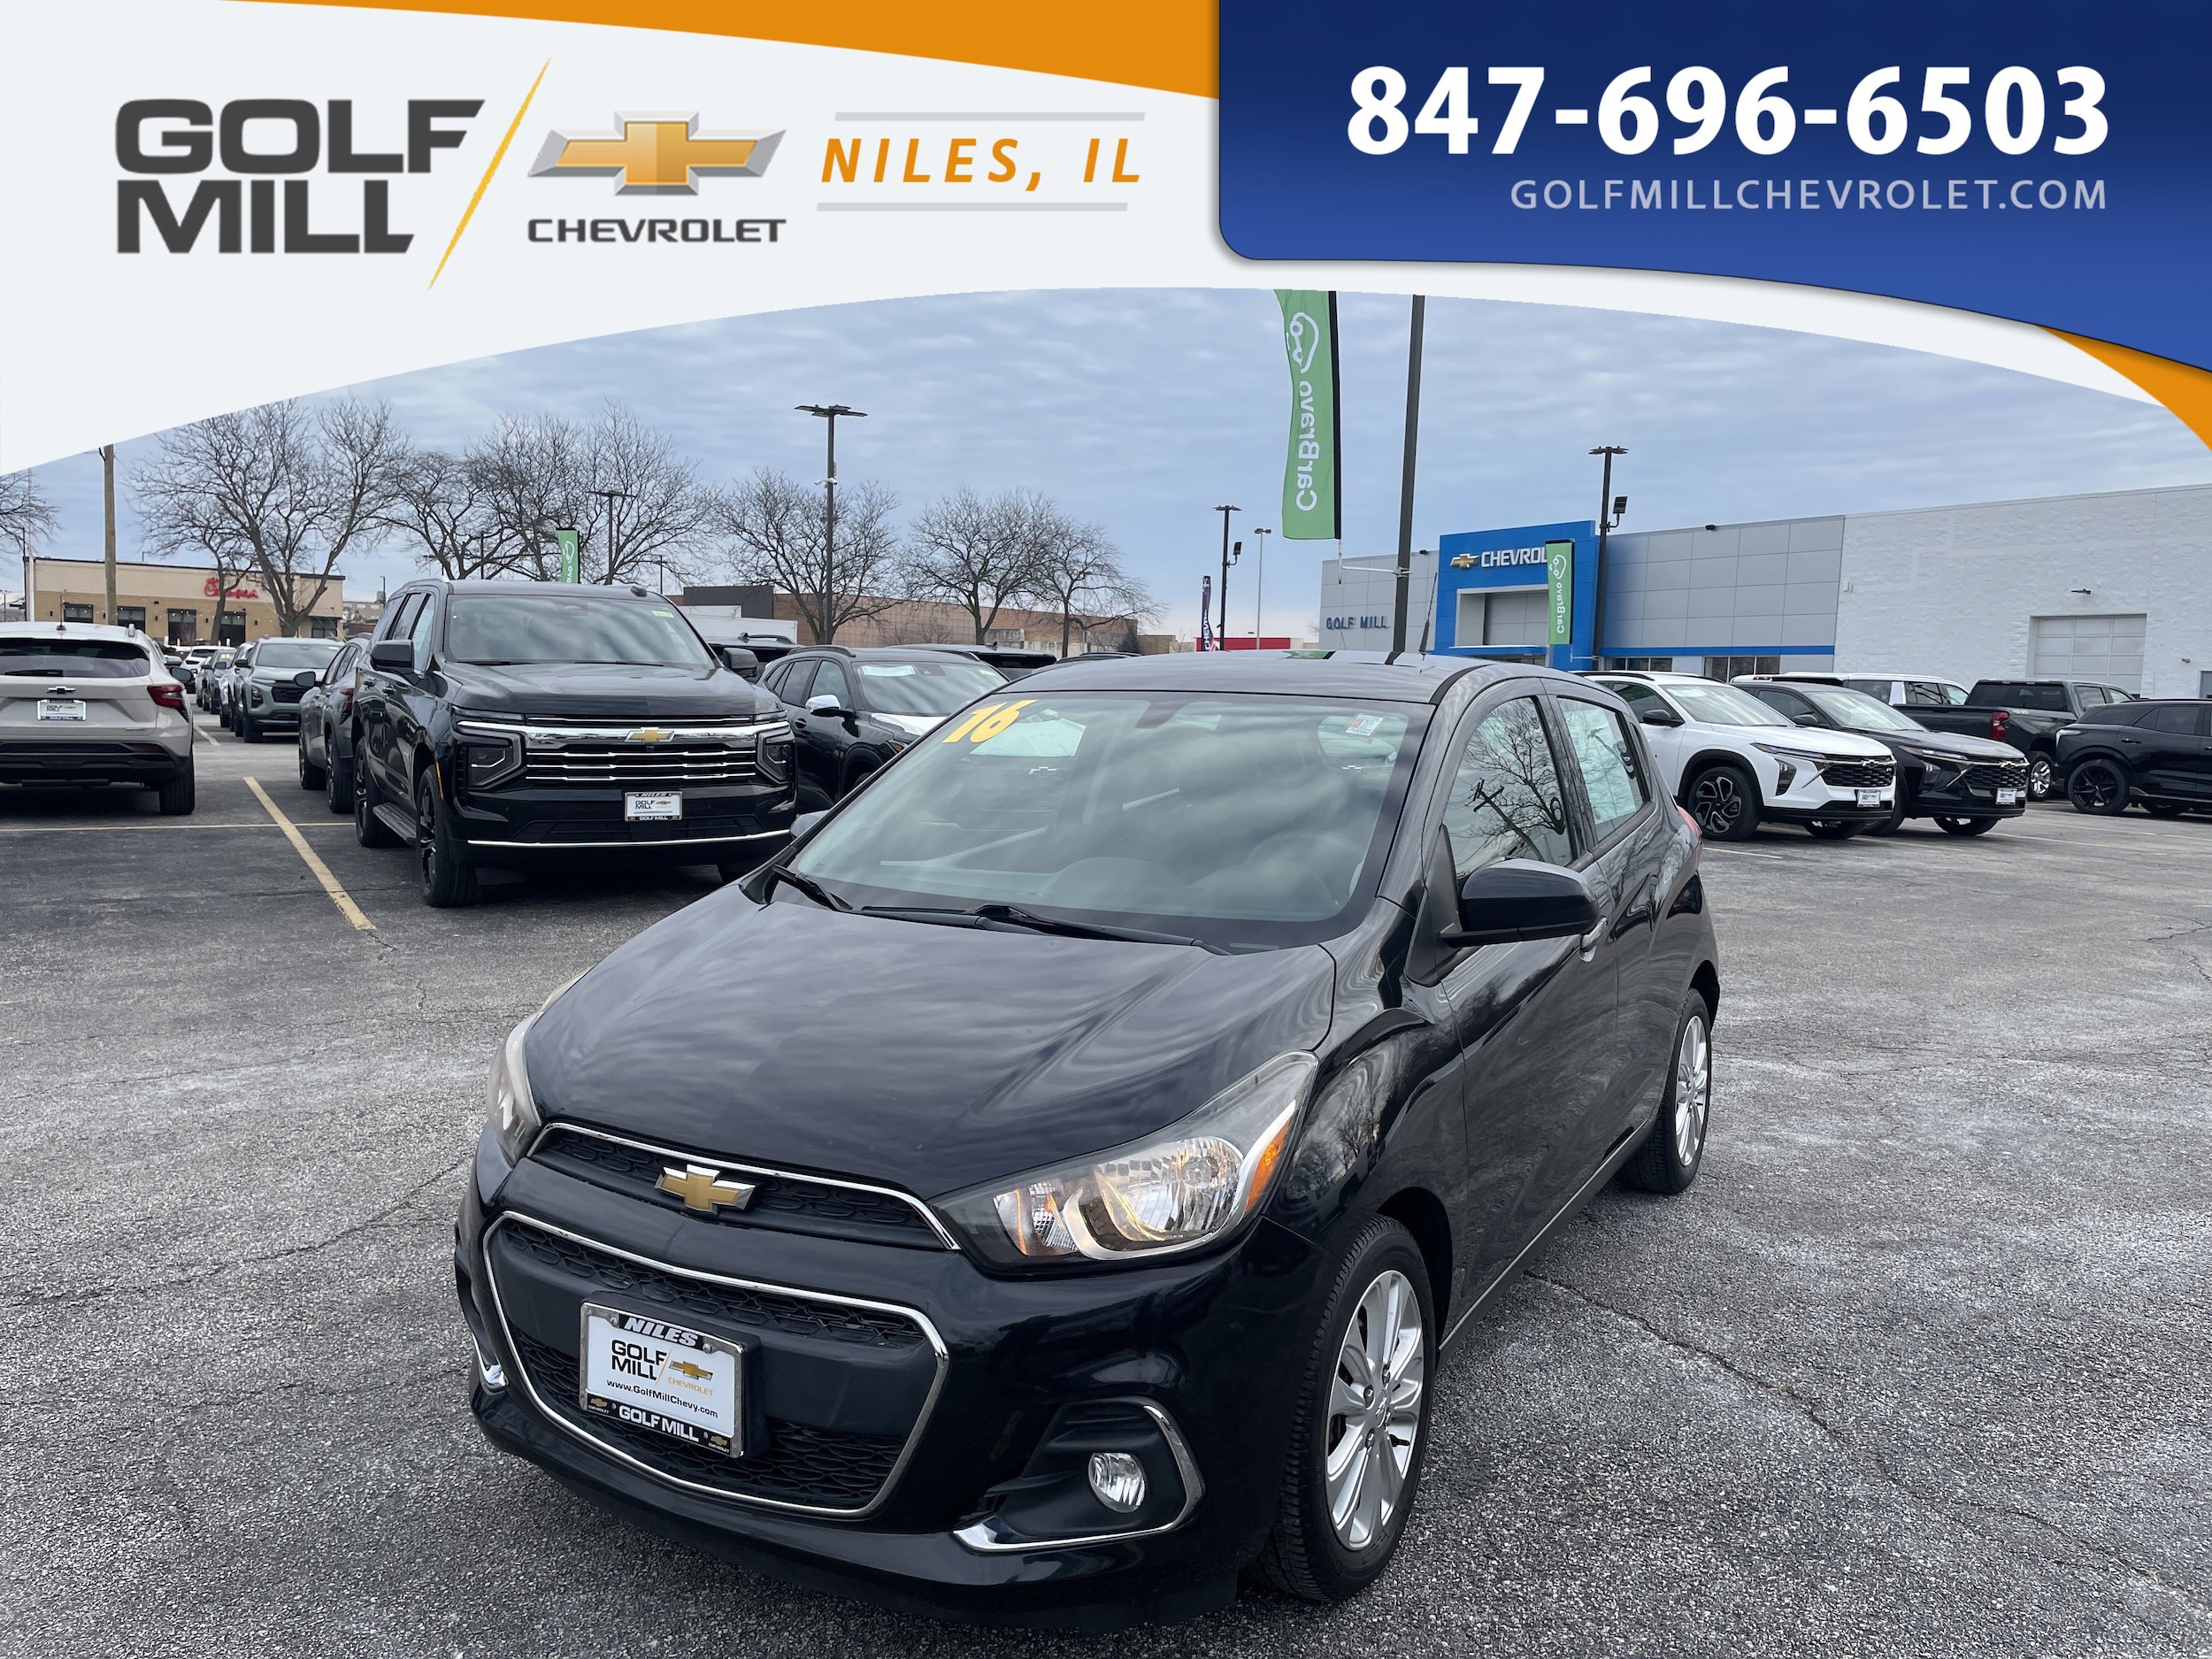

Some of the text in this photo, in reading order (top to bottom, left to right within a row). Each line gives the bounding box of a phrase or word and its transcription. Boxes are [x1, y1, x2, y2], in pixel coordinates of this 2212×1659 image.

[1480, 546, 1548, 568] CHEVROL
[1325, 615, 1386, 629] GOLF MILL
[942, 699, 1038, 743] 16
[624, 1317, 698, 1347] NILES
[611, 1340, 668, 1366] GOLF
[611, 1355, 657, 1381] MILL
[606, 1379, 718, 1418] www.GolfMillChevy.com
[668, 1377, 714, 1396] CHEVROLET
[618, 1405, 700, 1442] GOLF MILL
